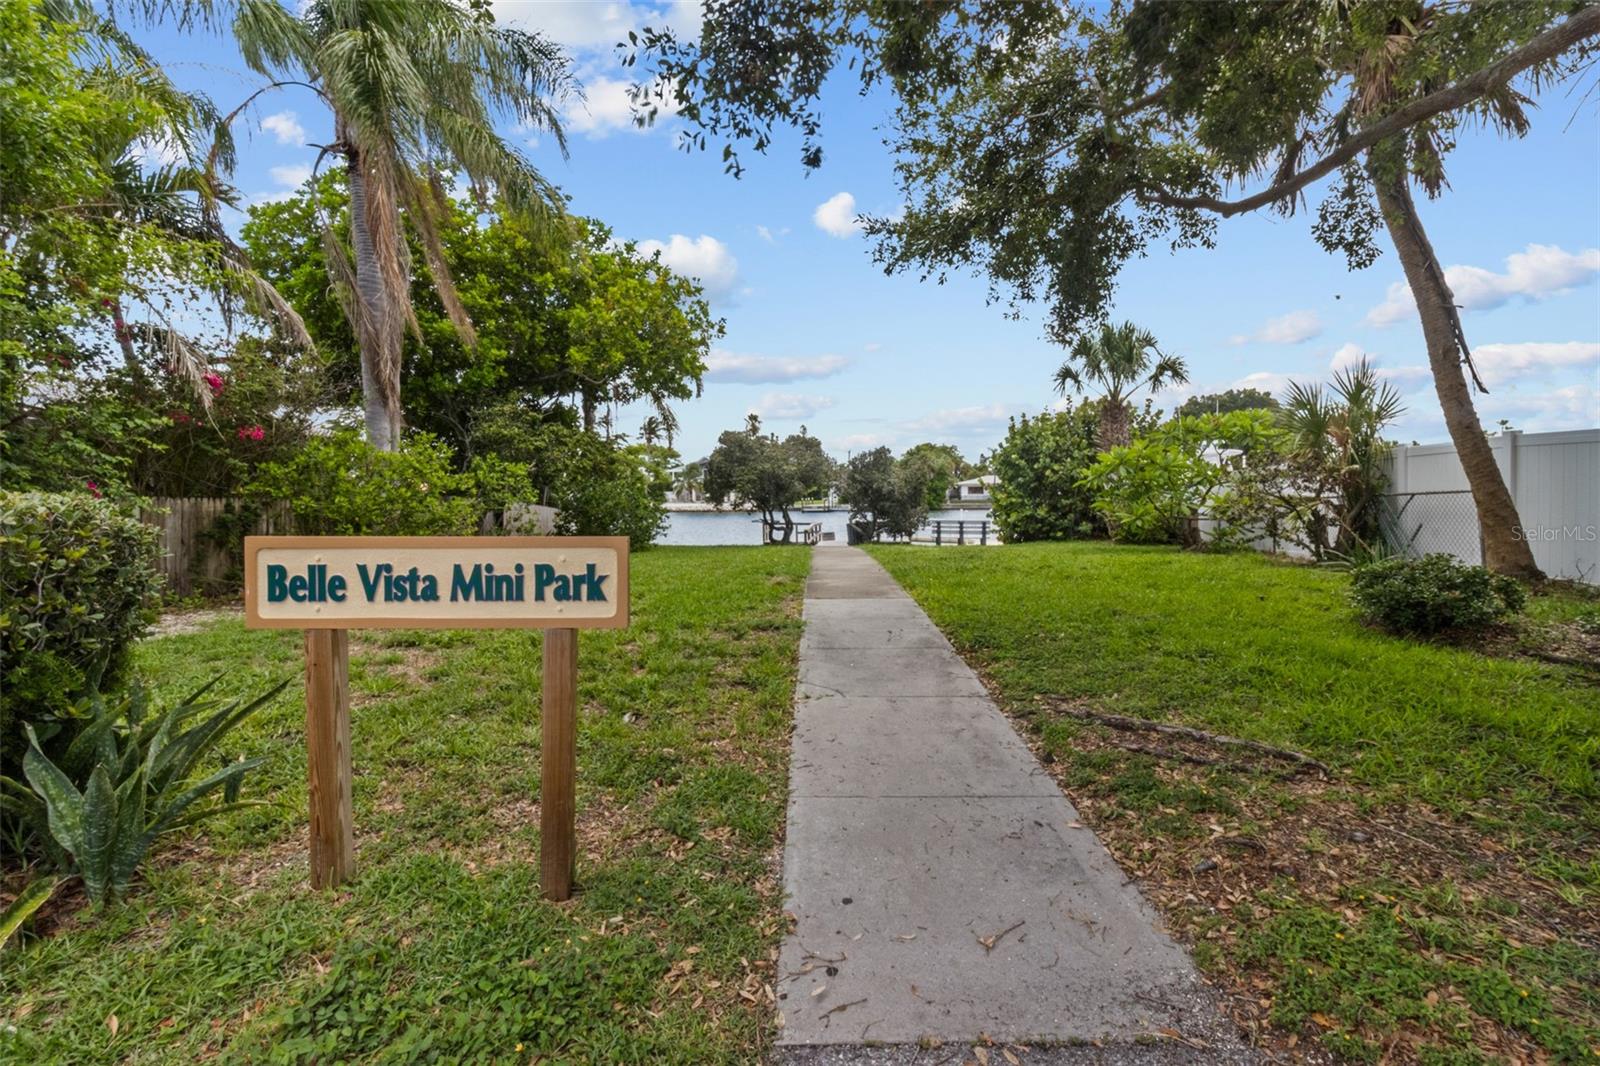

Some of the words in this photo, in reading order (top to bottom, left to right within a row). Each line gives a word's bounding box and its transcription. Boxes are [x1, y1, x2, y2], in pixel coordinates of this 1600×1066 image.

[266, 563, 347, 602] Belle
[356, 563, 439, 602] Vista
[449, 563, 525, 602] Mini
[534, 563, 610, 602] Park
